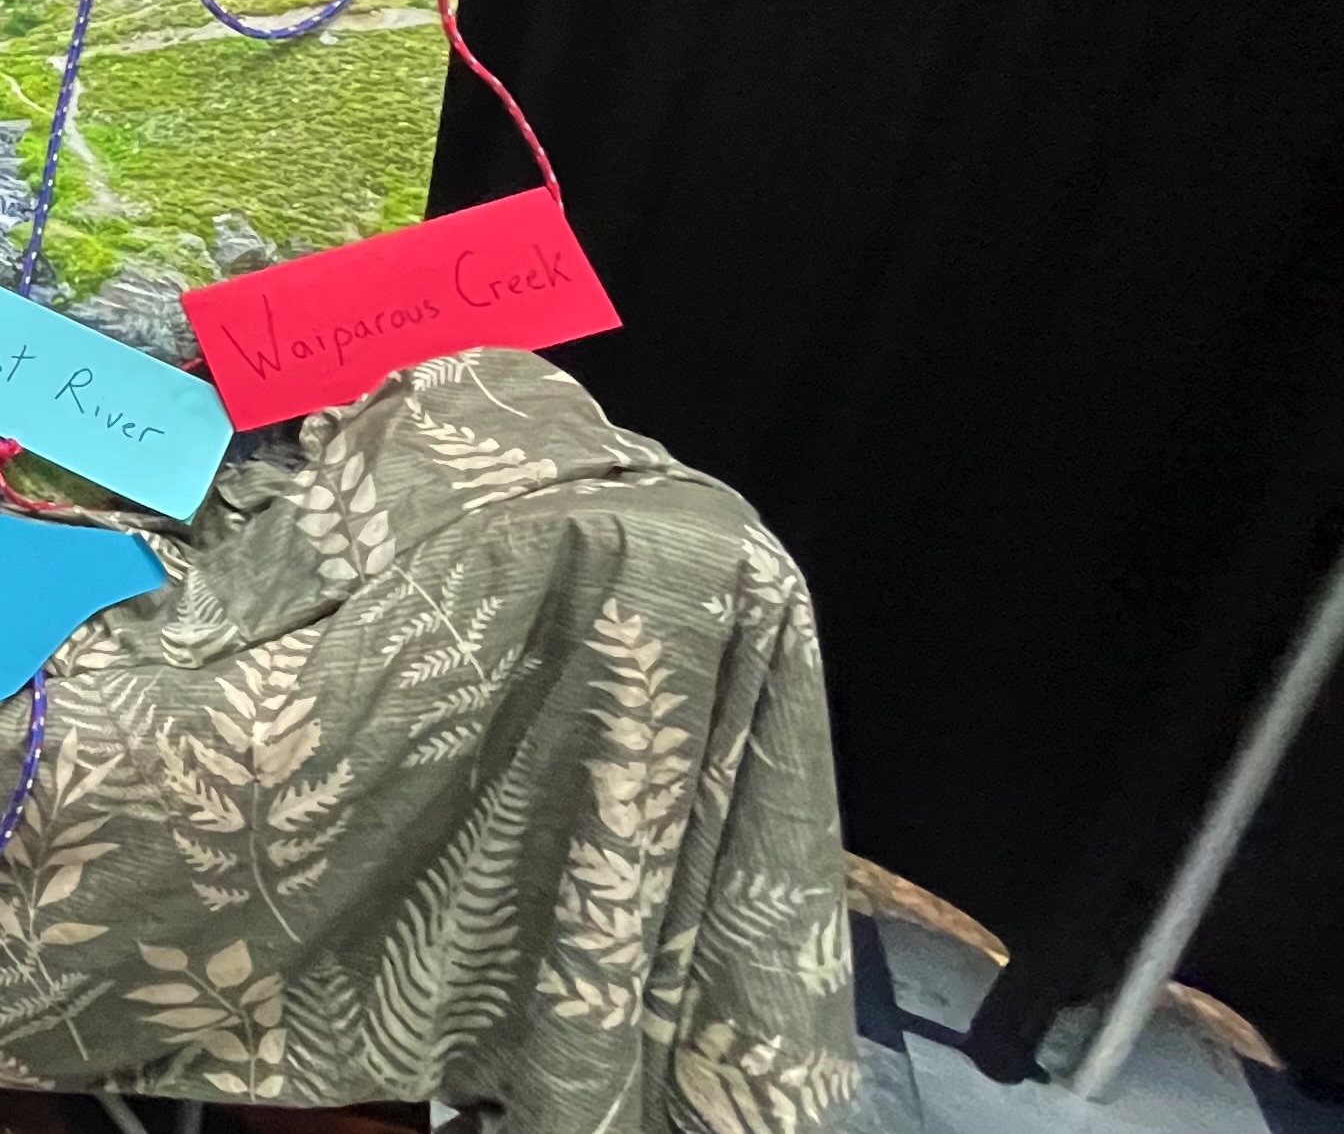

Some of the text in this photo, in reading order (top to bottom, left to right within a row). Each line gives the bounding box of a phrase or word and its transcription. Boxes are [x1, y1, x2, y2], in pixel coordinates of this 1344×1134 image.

[220, 243, 573, 381] Waiparous Creek
[54, 367, 166, 444] River
